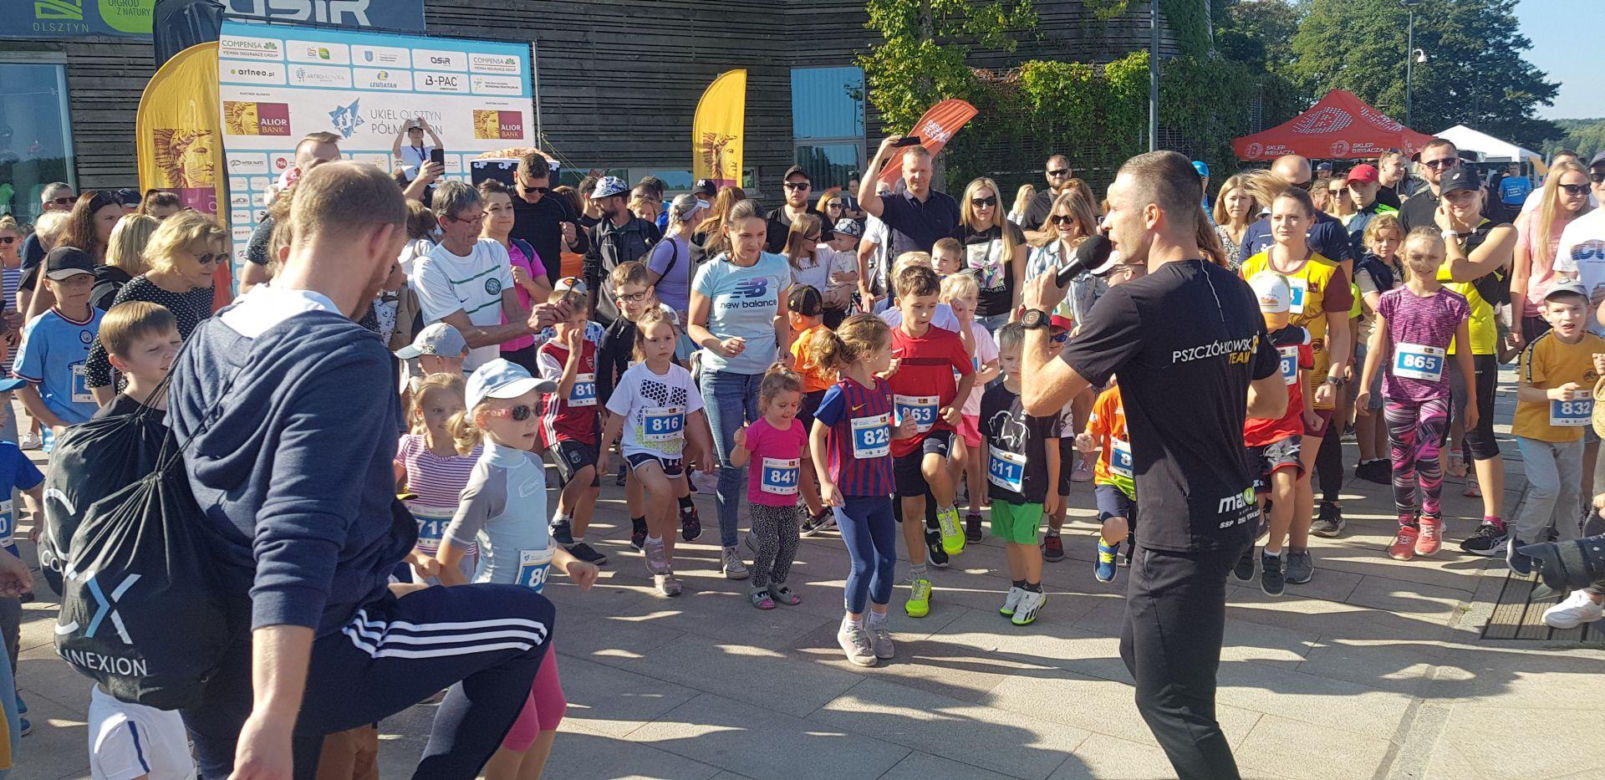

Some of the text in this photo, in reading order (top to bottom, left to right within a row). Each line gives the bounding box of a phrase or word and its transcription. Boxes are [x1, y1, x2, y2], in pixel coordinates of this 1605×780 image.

[123, 8, 151, 17] NATURY
[32, 22, 89, 33] OLSZTYN
[221, 40, 262, 50] COMPENSA
[237, 69, 275, 77] artneo.pl
[370, 109, 442, 121] UKIEL OLSZTYN
[260, 117, 288, 126] ALIOR
[720, 299, 777, 309] new balance
[1403, 354, 1436, 370] 865
[1561, 401, 1591, 415] 832
[652, 417, 679, 431] 816
[863, 426, 889, 445] 829
[991, 458, 1014, 478] 811
[770, 470, 796, 484] 841
